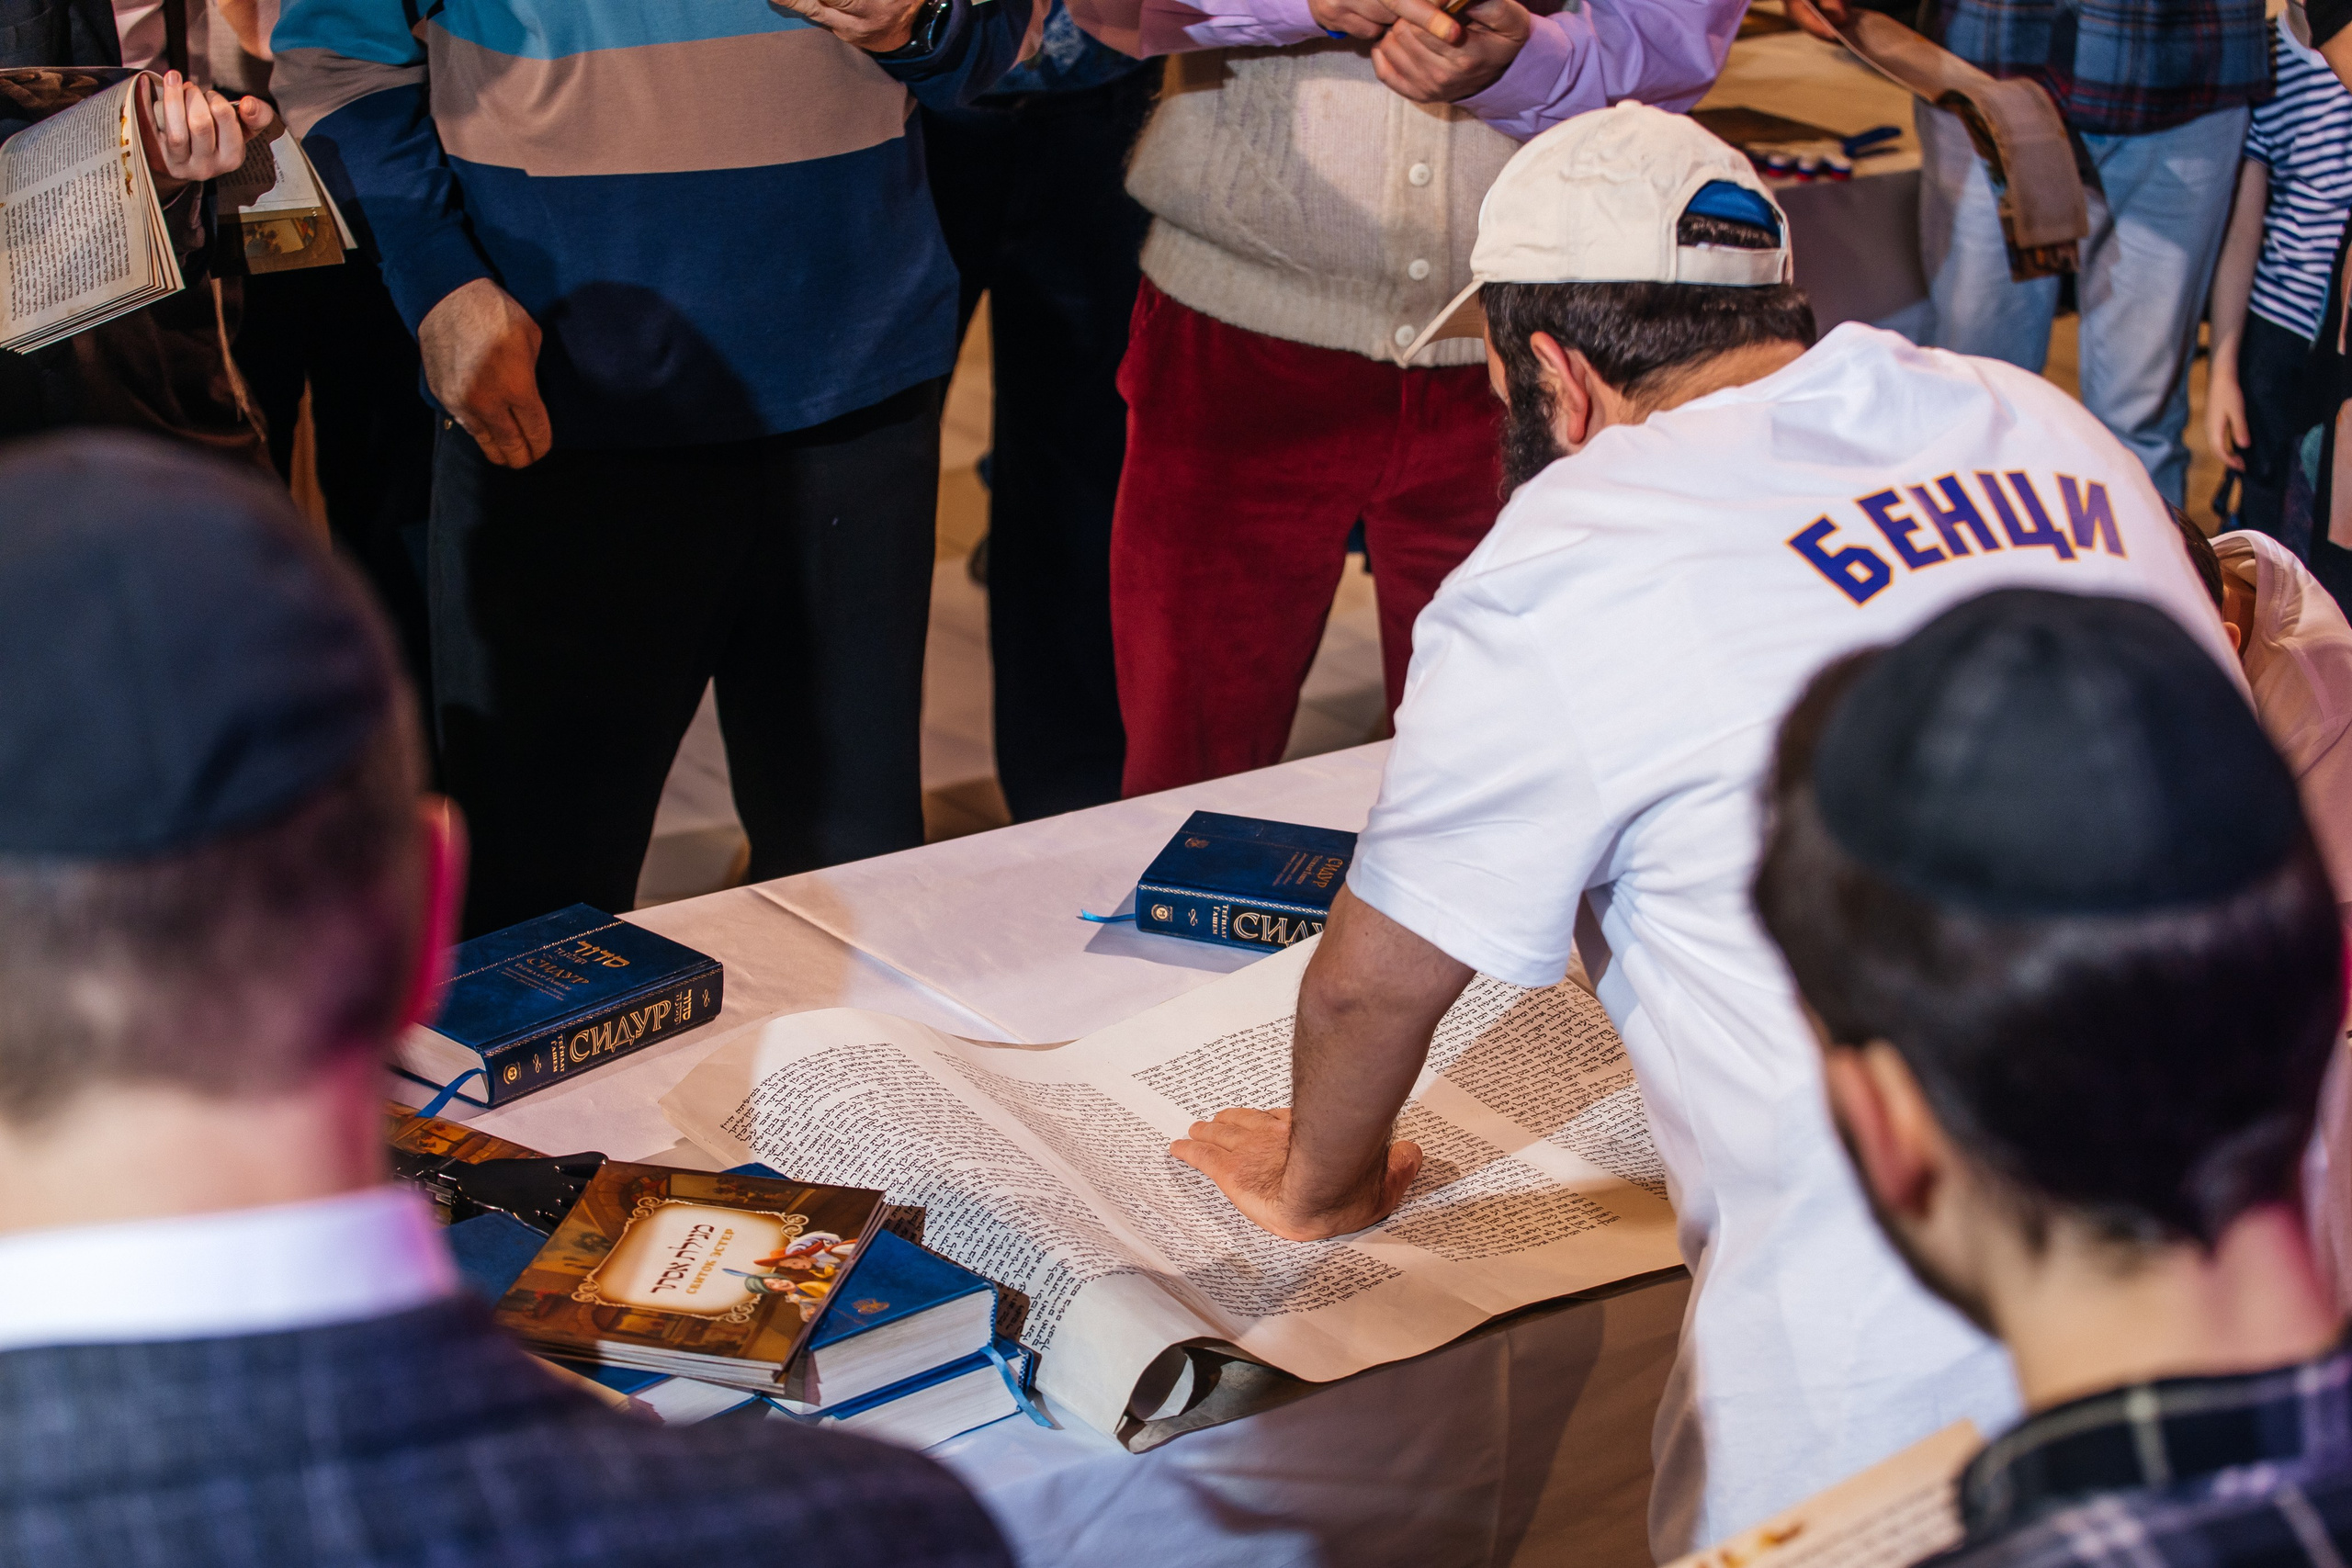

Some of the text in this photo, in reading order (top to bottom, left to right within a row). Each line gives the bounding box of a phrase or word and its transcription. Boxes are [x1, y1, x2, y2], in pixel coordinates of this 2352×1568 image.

[1783, 468, 2129, 608] БЕНЦИ
[1233, 911, 1324, 948] СИД
[574, 941, 630, 968] סדור
[526, 958, 590, 984] СИДУР
[1512, 996, 1533, 1009] אשר
[1527, 998, 1553, 1011] מדינה
[1546, 998, 1568, 1011] המלך
[1495, 1009, 1511, 1018] על
[1502, 1010, 1529, 1027] ומדינה
[1549, 1010, 1583, 1031] להשמיד
[570, 999, 672, 1063] СИДУР
[1474, 1017, 1499, 1031] מדינה
[1520, 1023, 1544, 1038] ספרים
[1573, 1023, 1599, 1038] לחדש
[1445, 1030, 1473, 1043] ומדינה
[1476, 1026, 1502, 1040] ככתבה
[1488, 1032, 1510, 1043] נכתב
[1524, 1032, 1547, 1045] להרג
[1560, 1026, 1574, 1037] זקן
[1460, 1038, 1476, 1046] ועם
[1548, 1035, 1560, 1043] טף
[1554, 1038, 1572, 1051] שנים
[1526, 1042, 1548, 1054] ונשים
[650, 1224, 715, 1293] מגילת אסתר
[685, 1228, 734, 1294] СВИТОК ЭСТЕР
[1039, 1299, 1071, 1351] בשם המלך
